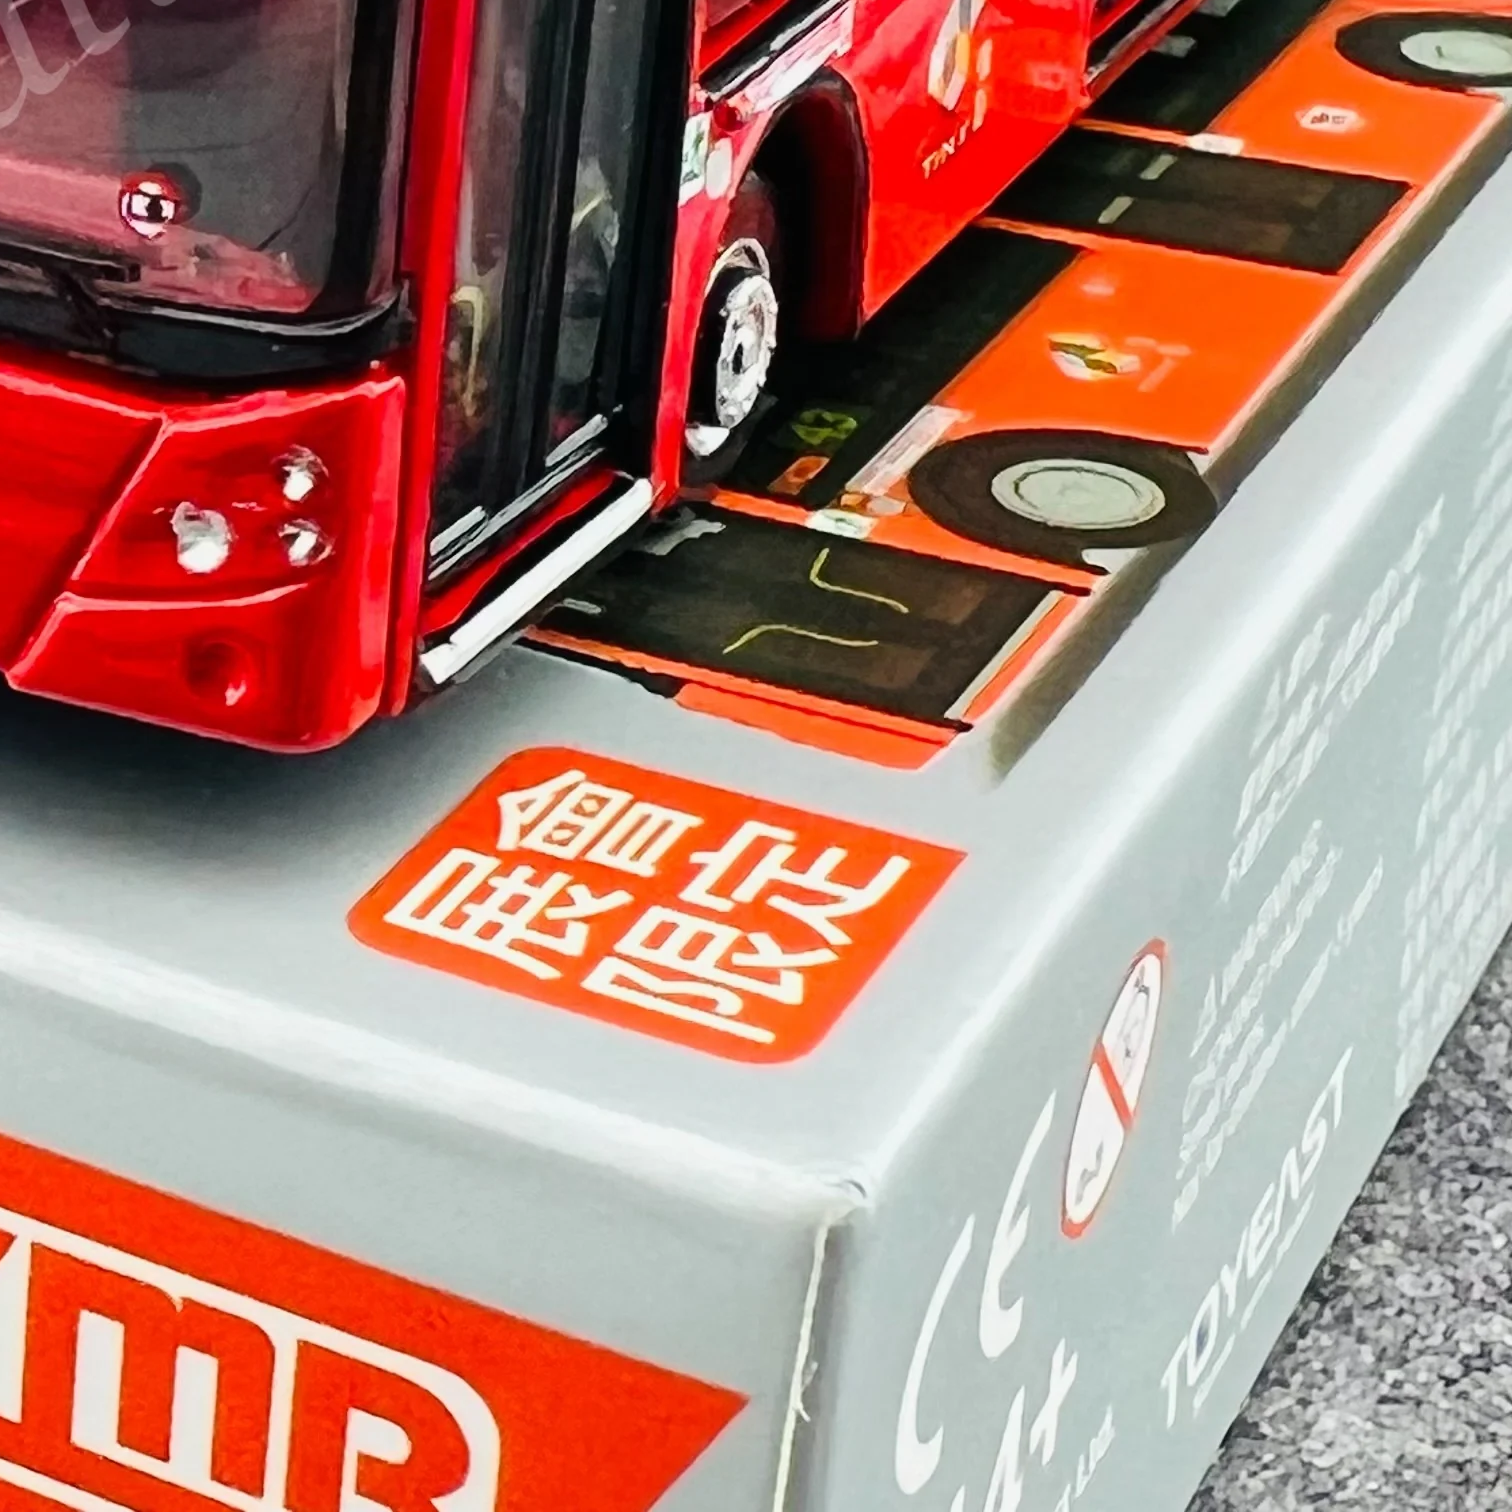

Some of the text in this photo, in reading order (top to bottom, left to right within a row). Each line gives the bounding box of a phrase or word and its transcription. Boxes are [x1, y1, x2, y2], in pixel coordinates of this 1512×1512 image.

[385, 769, 702, 980] 展會
[582, 820, 911, 1042] 限定
[1161, 1044, 1355, 1430] TOYEAST
